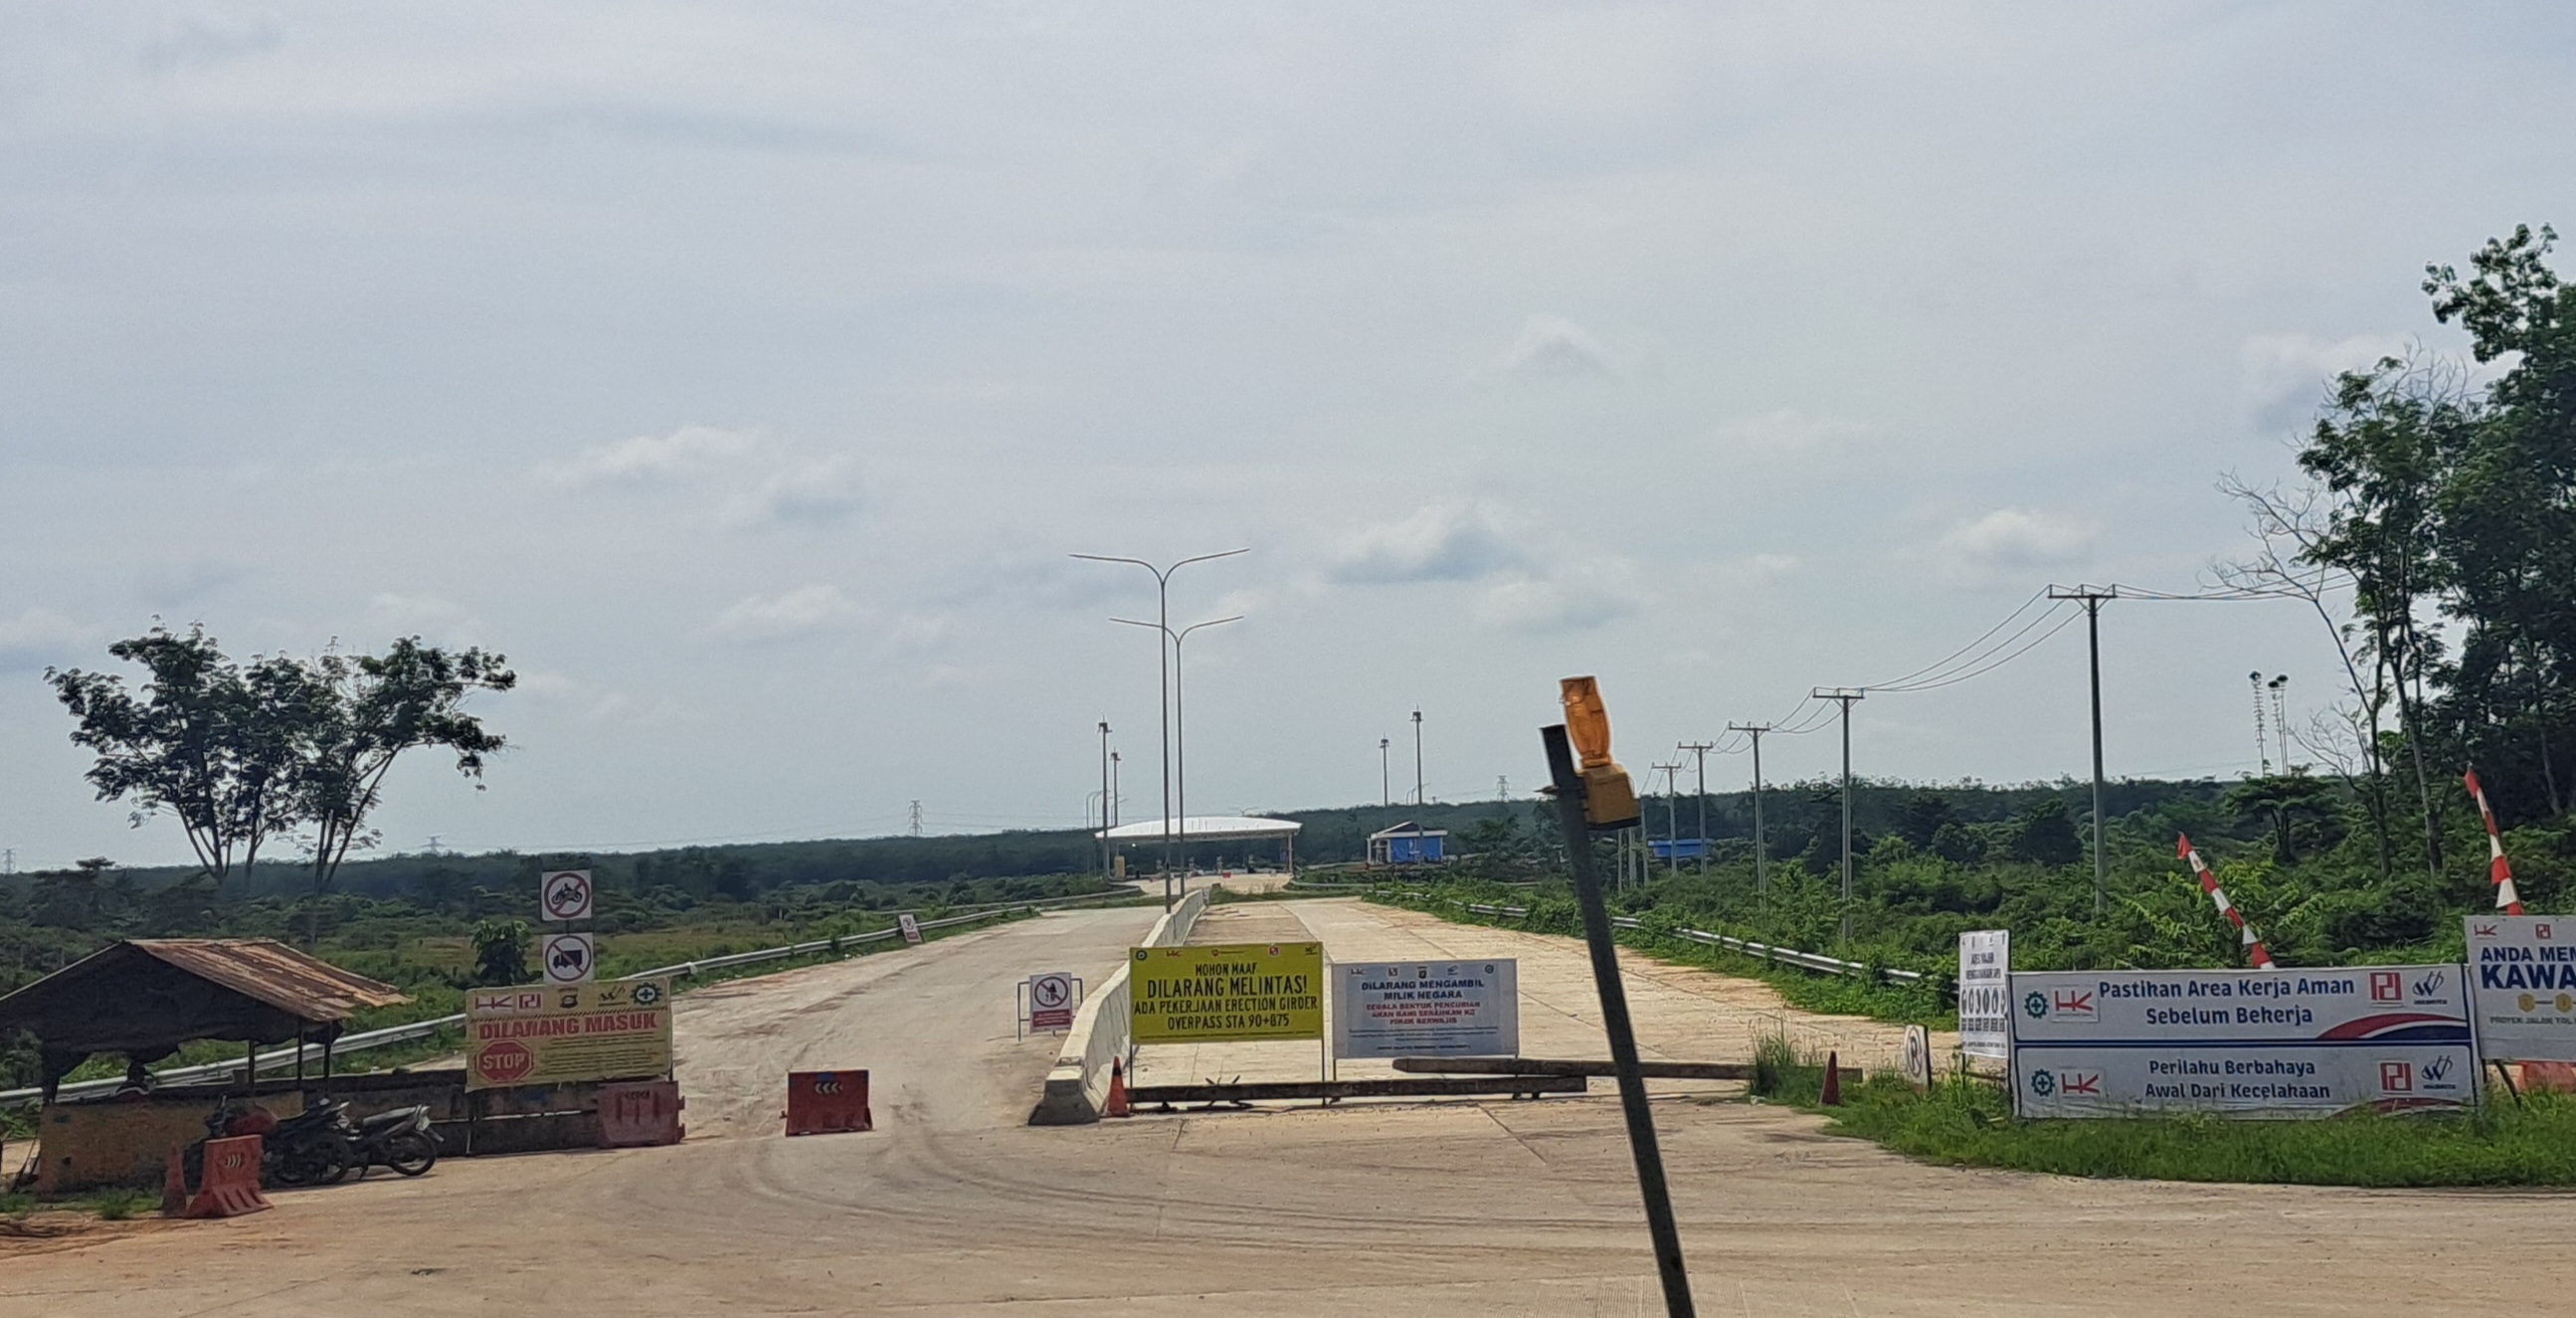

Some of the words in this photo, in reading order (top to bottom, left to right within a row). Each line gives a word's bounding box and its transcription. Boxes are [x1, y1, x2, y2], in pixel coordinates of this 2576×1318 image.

[2481, 947, 2534, 962] ANDA
[1196, 964, 1228, 976] MOHON
[1231, 962, 1258, 975] MAAF
[1147, 978, 1224, 999] DILARANG
[1229, 975, 1308, 996] MELINTAS!
[1362, 981, 1416, 991] DILARANG
[1419, 979, 1485, 989] MENGAMBIL
[2100, 979, 2181, 998] Pastikan
[2188, 980, 2232, 997] Area
[2238, 977, 2291, 999] Kerja
[2297, 977, 2355, 996] Aman
[1383, 992, 1414, 1001] MILIK
[1417, 990, 1462, 1000] NEGARA
[1134, 1000, 1156, 1015] ADA
[1160, 998, 1222, 1015] PEKERJAAN
[1225, 997, 1276, 1012] ERECTION
[1279, 996, 1318, 1011] GIRDER
[585, 1013, 657, 1034] MASUK
[1168, 1015, 1222, 1031] OVERPASS
[1225, 1014, 1244, 1029] STA
[2146, 1005, 2230, 1025] Sebelum
[2236, 1005, 2313, 1027] Bekerja
[482, 1052, 526, 1070] STOP
[2149, 1059, 2220, 1075] Perilaku
[2225, 1059, 2315, 1080] Berbahaya
[2145, 1083, 2185, 1098] Awal
[2191, 1082, 2226, 1098] Dari
[2230, 1082, 2330, 1099] Kecelakaan
